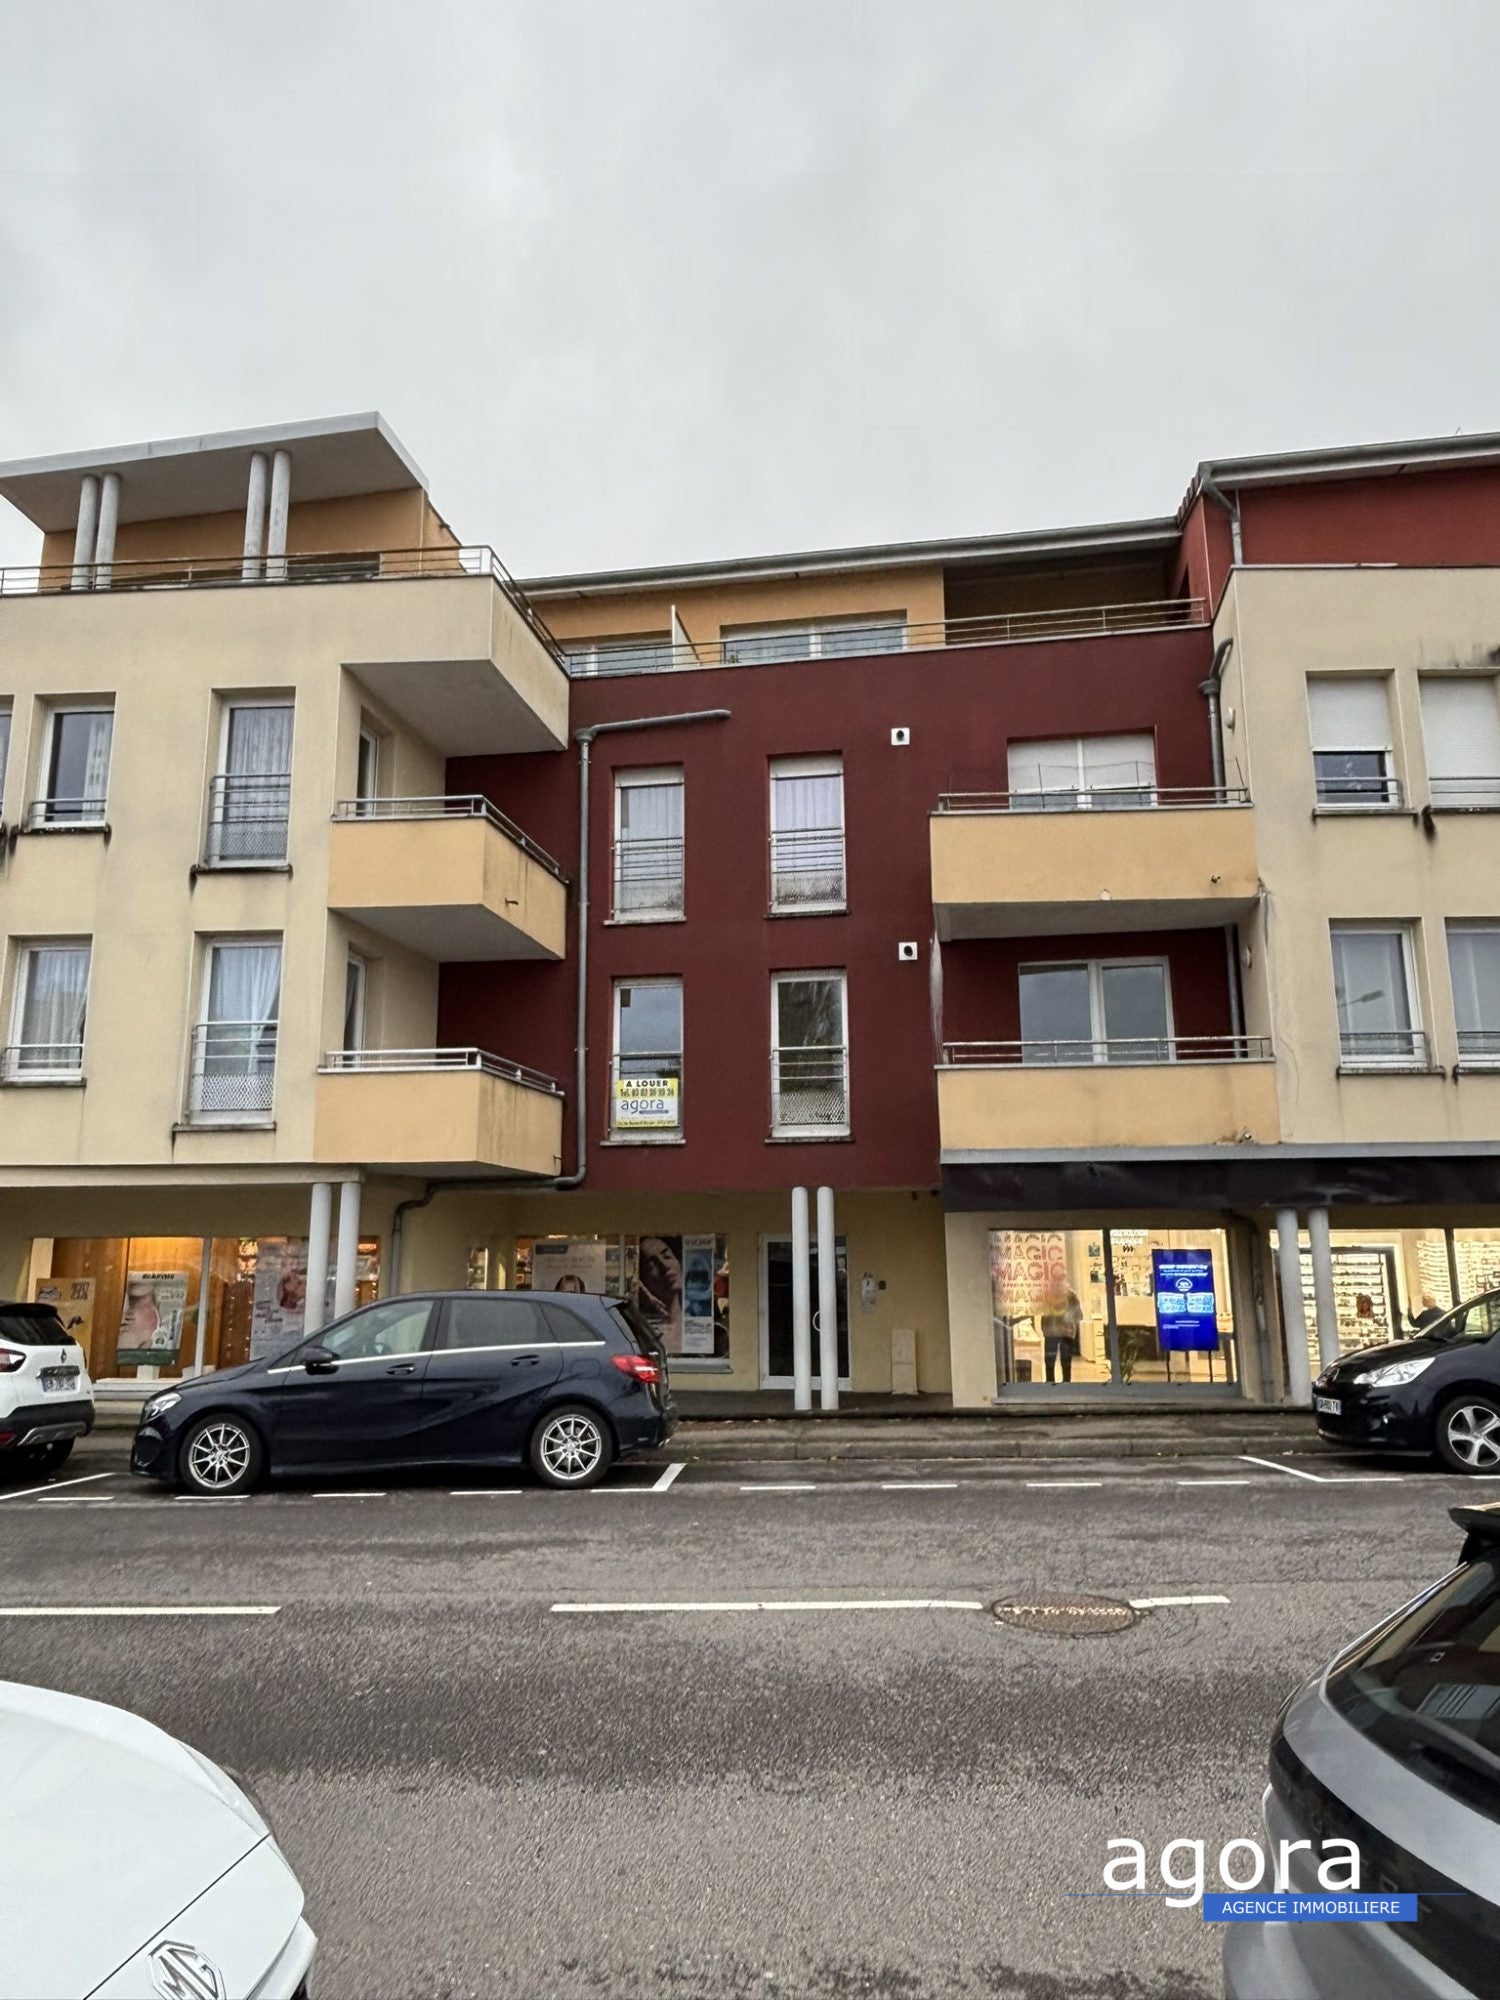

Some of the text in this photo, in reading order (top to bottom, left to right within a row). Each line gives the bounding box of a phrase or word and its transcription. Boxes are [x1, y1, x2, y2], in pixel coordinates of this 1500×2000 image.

[621, 1099, 664, 1114] agora
[991, 1245, 1063, 1260] MAGIC
[993, 1262, 1066, 1280] MAGIC
